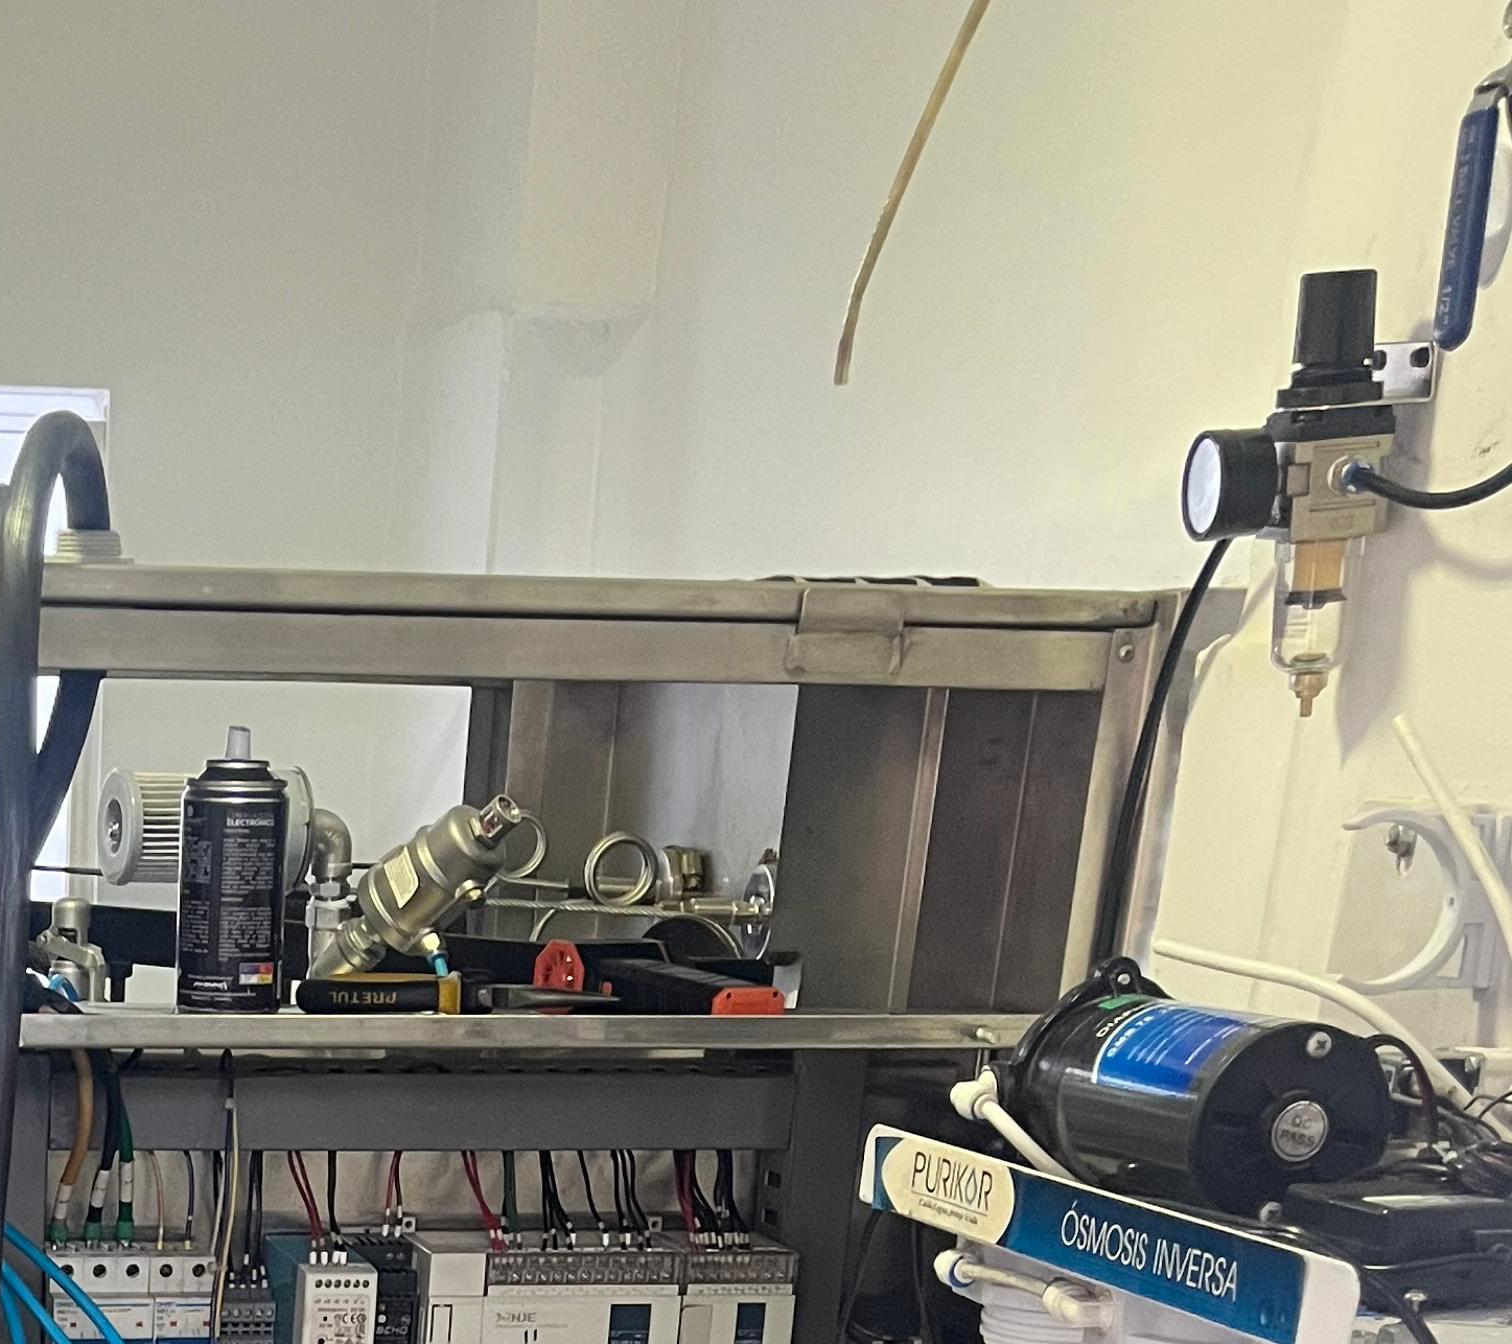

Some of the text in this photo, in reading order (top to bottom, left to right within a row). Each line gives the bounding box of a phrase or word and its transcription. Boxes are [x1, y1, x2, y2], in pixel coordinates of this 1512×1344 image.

[328, 991, 397, 1005] PRETUL
[1291, 1115, 1313, 1129] QC
[1279, 1129, 1316, 1147] PASS
[912, 1151, 992, 1211] PURIKOR
[1061, 1202, 1237, 1301] ÓSMOSIS INVERSA
